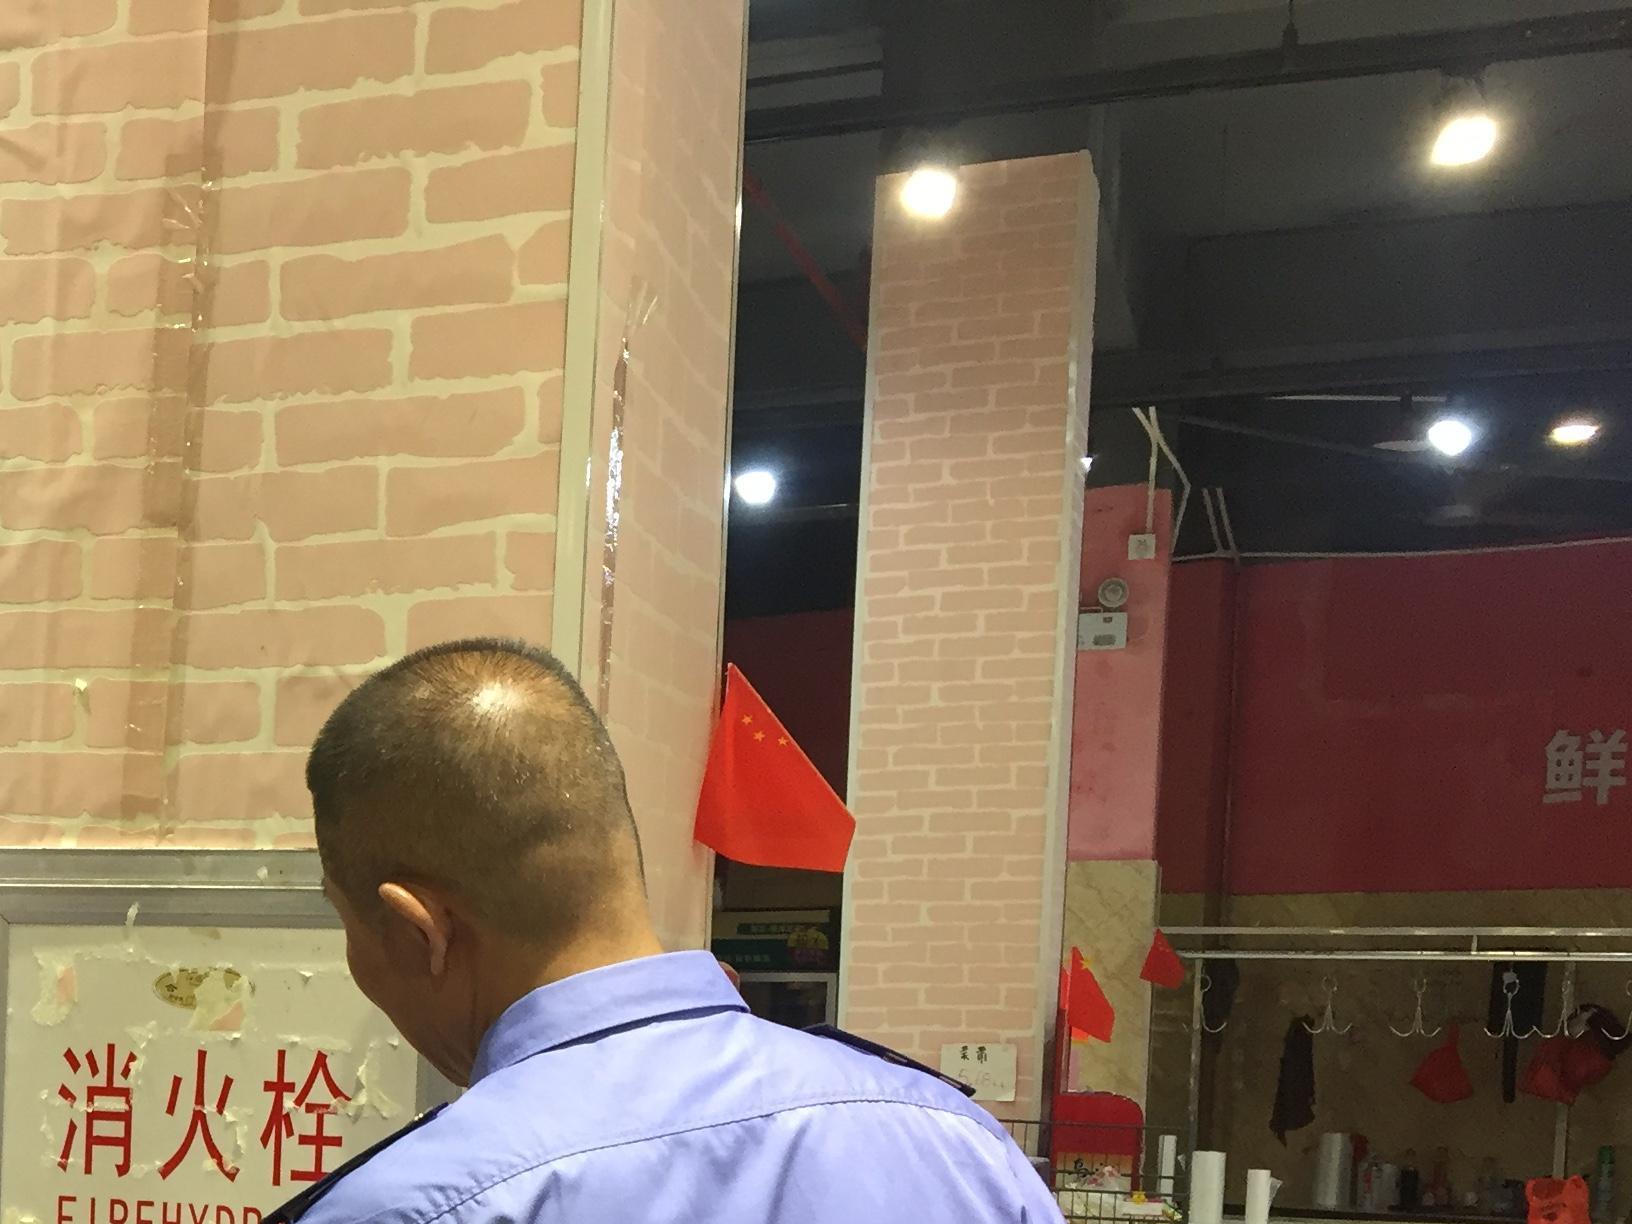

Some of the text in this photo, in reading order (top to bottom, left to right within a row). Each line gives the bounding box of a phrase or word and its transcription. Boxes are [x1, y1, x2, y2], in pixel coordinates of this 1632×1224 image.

[1543, 728, 1629, 806] 鲜
[58, 1043, 353, 1187] 消火栓
